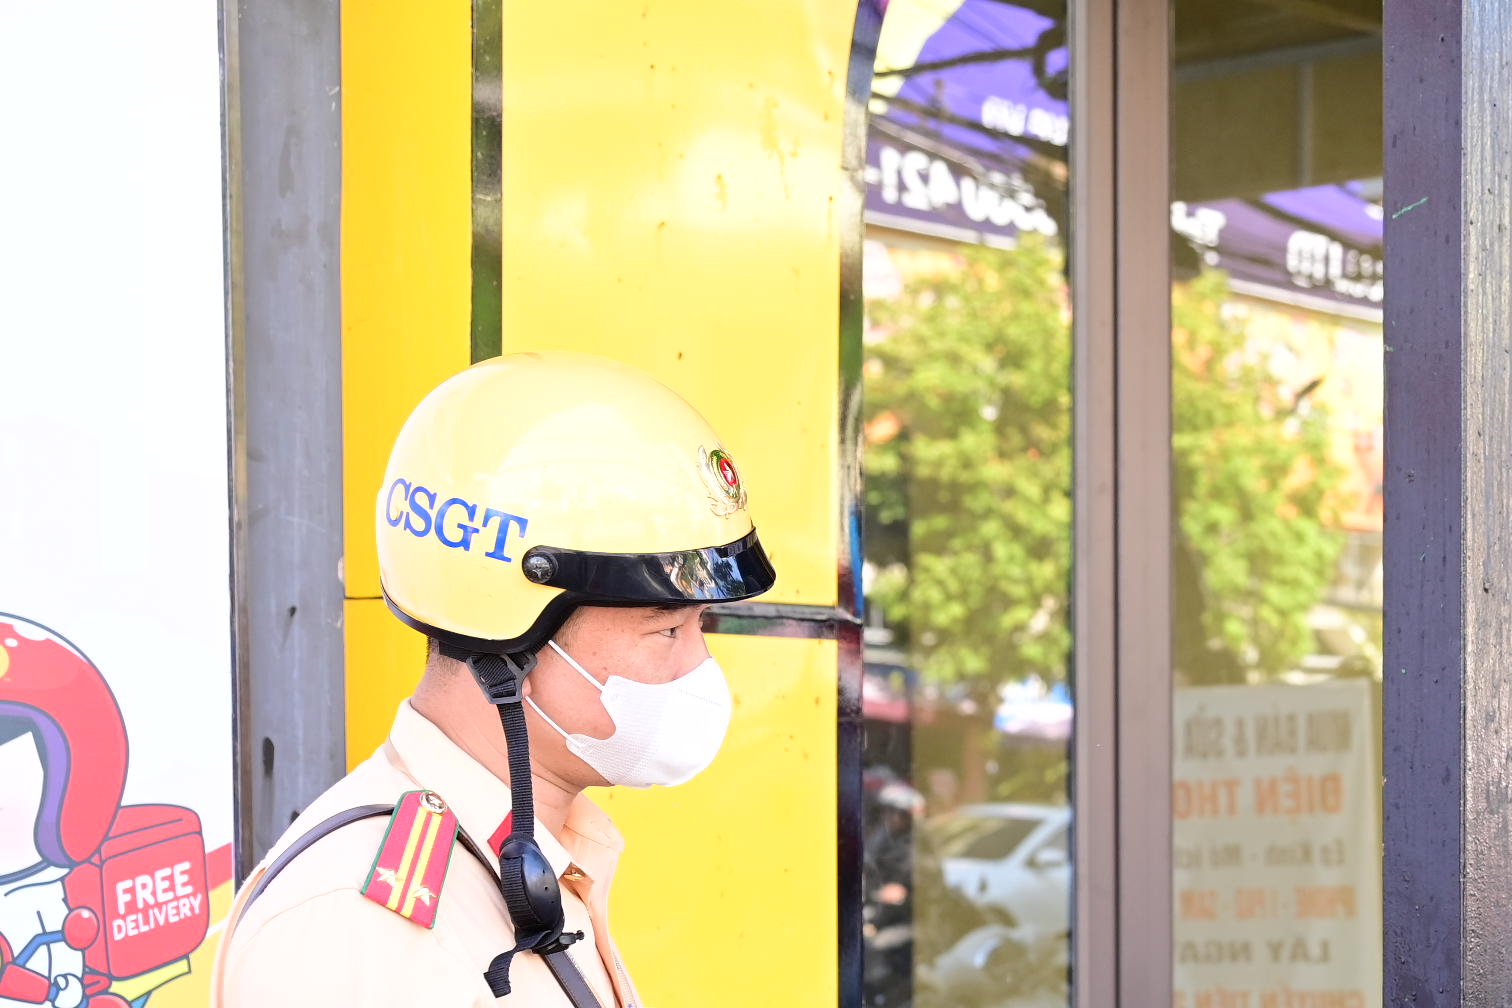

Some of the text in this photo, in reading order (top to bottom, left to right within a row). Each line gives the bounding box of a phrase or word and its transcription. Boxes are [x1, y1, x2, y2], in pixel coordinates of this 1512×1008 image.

[385, 477, 528, 563] CSGT
[116, 861, 193, 915] FREE
[112, 893, 202, 941] DELIVERY
